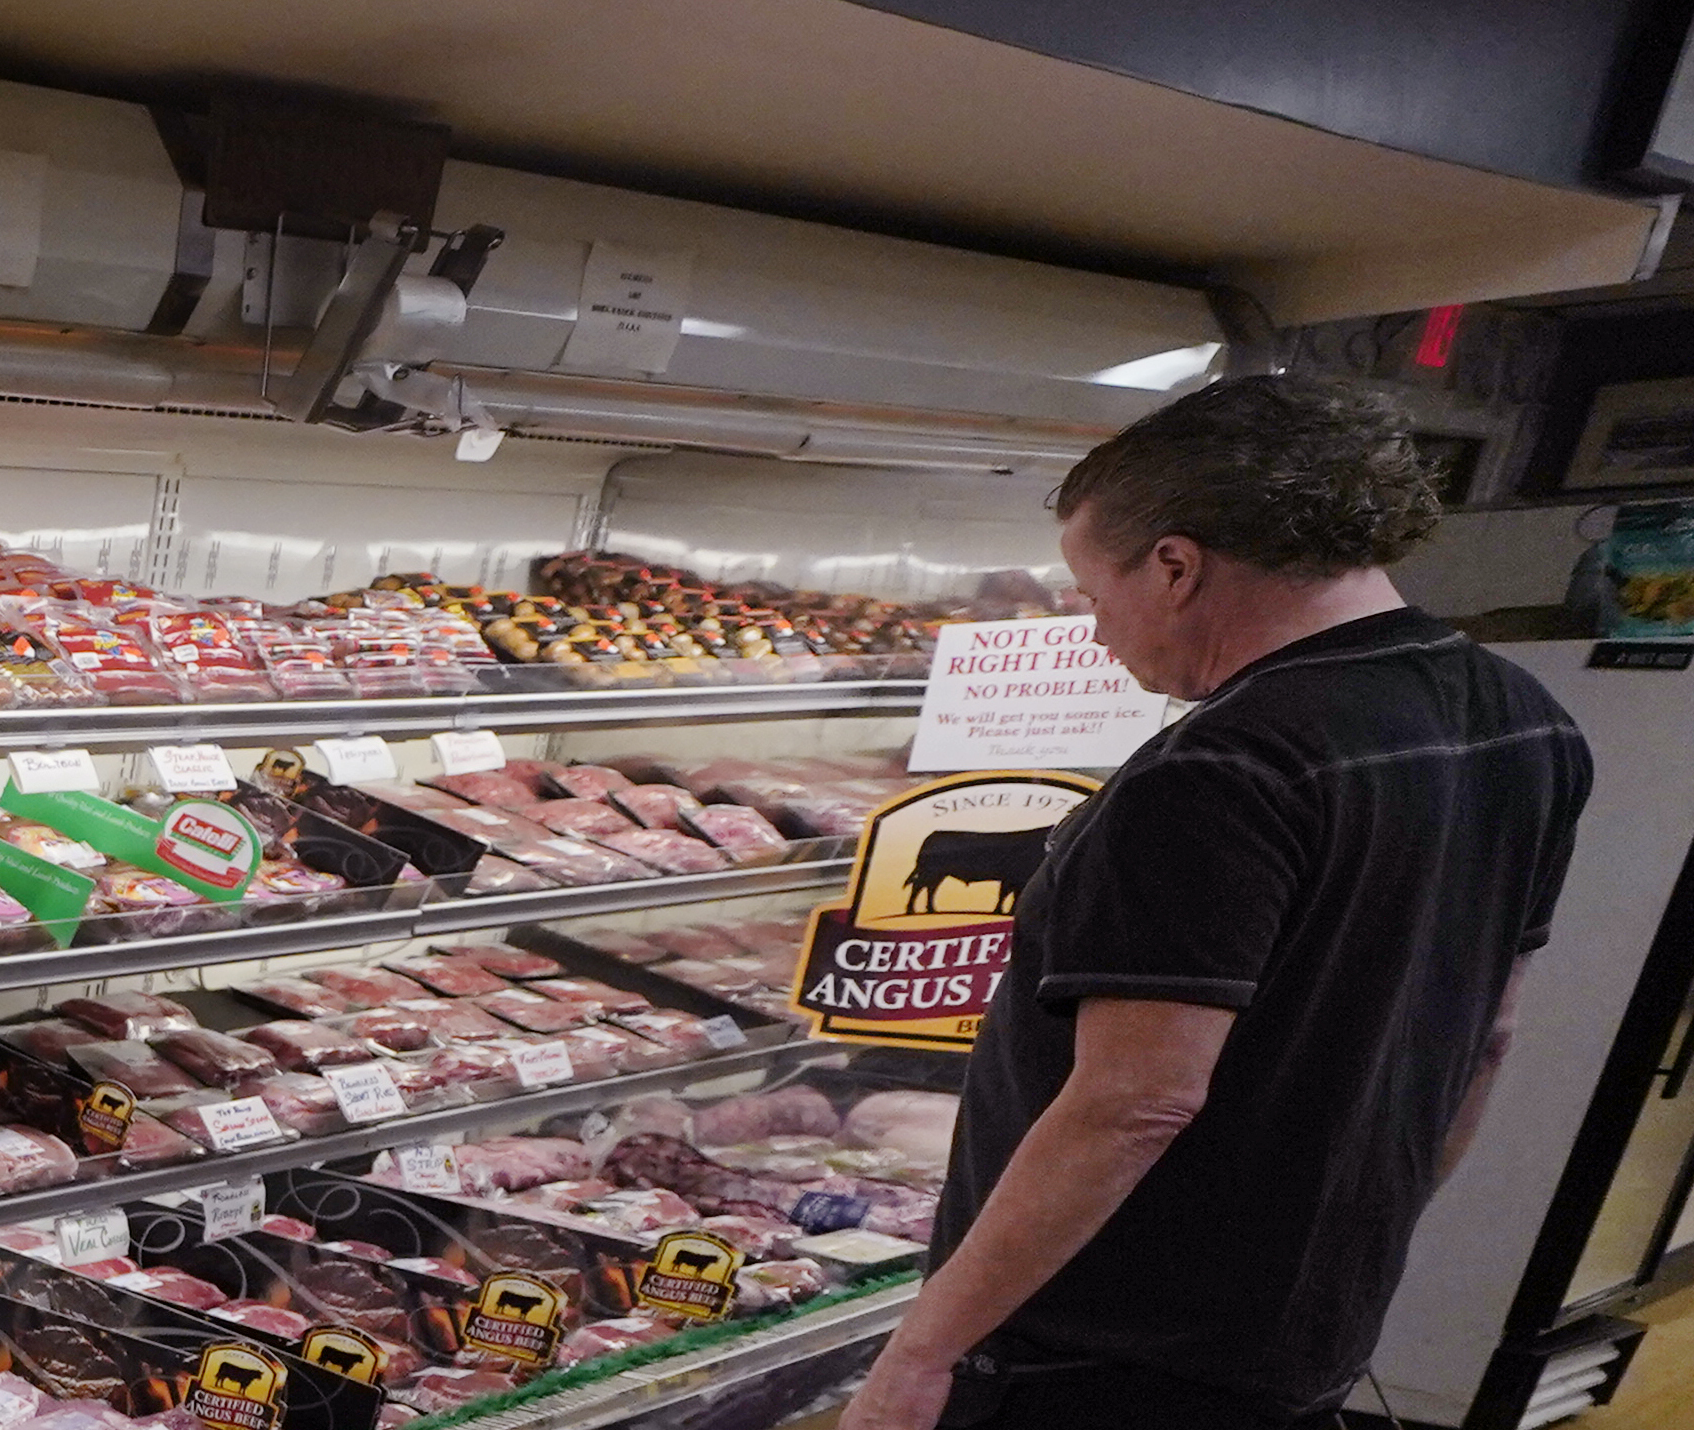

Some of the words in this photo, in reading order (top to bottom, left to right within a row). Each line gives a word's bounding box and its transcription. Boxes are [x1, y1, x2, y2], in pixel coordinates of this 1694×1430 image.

[969, 628, 1038, 651] NOT
[1044, 624, 1090, 645] GO
[947, 652, 1046, 676] RIGHT
[963, 684, 998, 700] NO
[1003, 677, 1130, 699] PROBLEM!
[937, 712, 960, 725] We
[966, 711, 995, 723] will
[999, 711, 1026, 725] get
[1030, 712, 1059, 725] you
[1065, 710, 1109, 721] some
[1114, 706, 1145, 720] ice.
[967, 725, 1019, 737] Please
[1024, 725, 1055, 737] just
[1060, 722, 1103, 736] ask!!
[932, 793, 1011, 817] SINCE
[1023, 793, 1079, 813] 197
[807, 973, 974, 1010] ANGUS
[648, 1273, 719, 1296] CERTIFIED
[467, 1327, 513, 1345] ANGUS
[474, 1315, 545, 1338] CERTIFIED
[194, 1390, 264, 1416] CERTIFIED
[186, 1402, 232, 1423] ANGUS
[233, 1413, 266, 1430] BEEF
